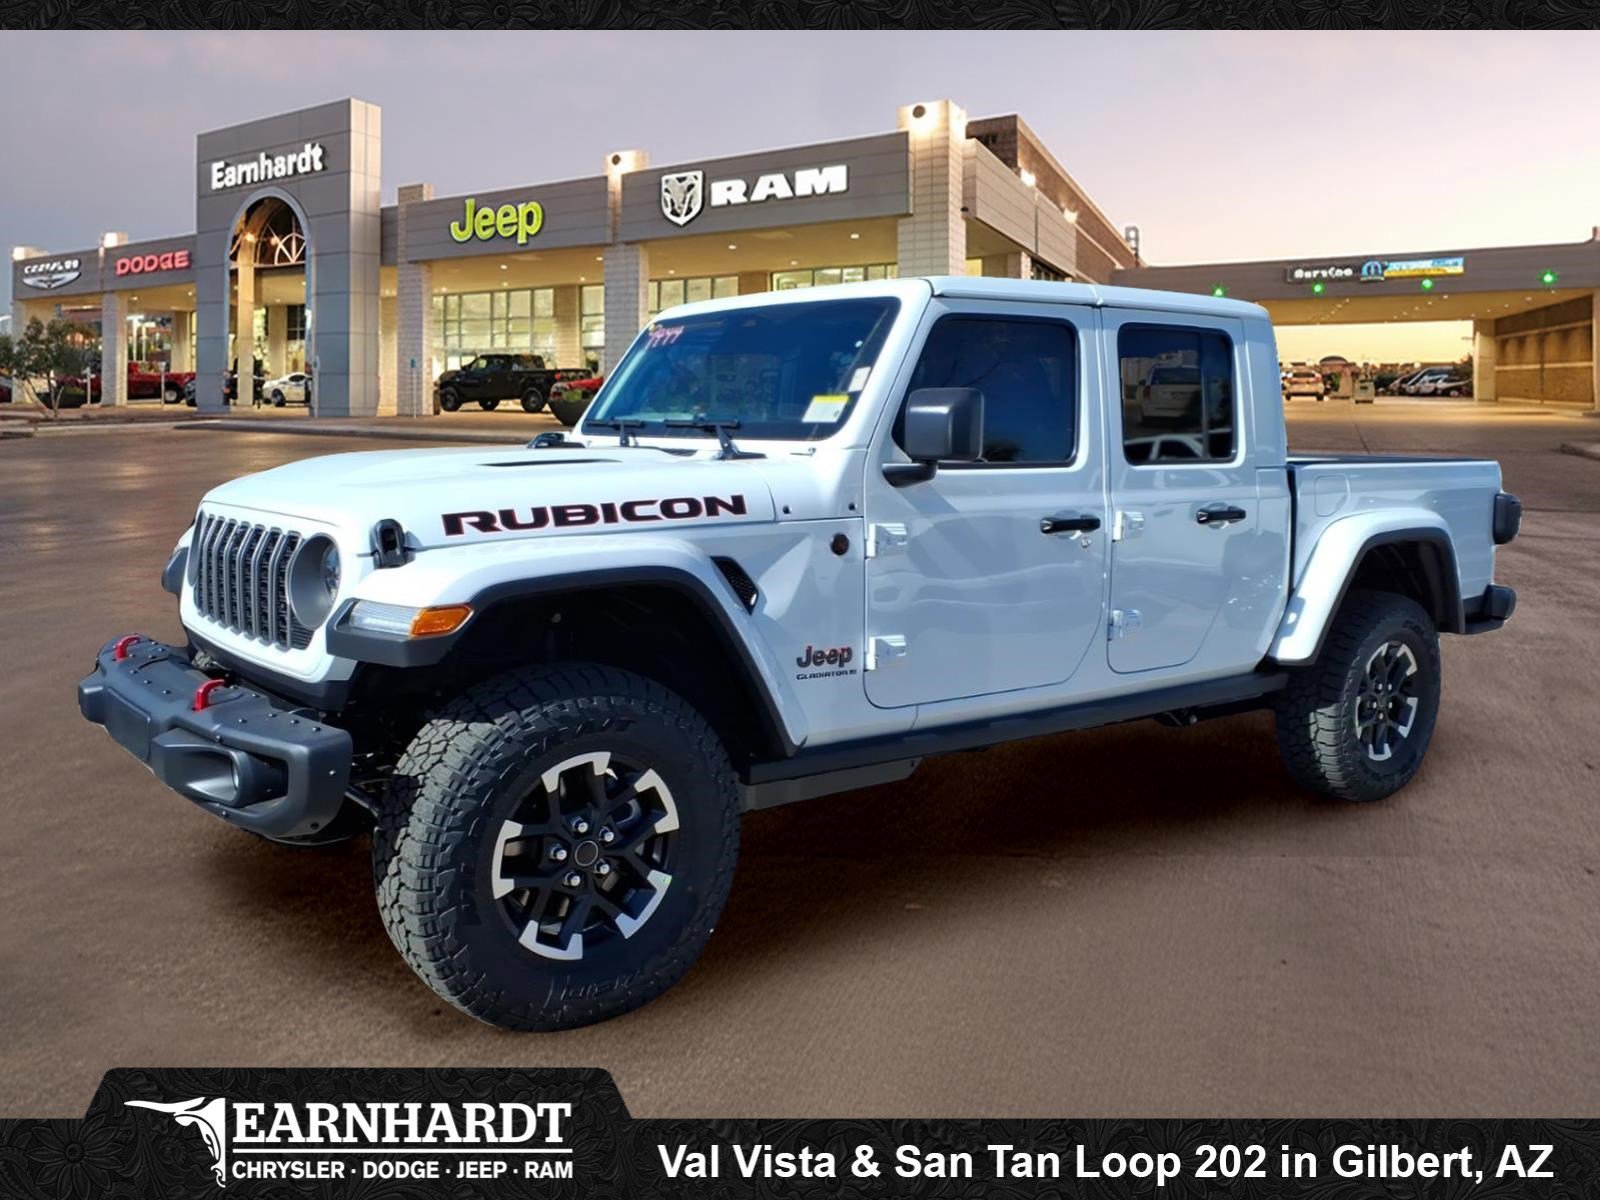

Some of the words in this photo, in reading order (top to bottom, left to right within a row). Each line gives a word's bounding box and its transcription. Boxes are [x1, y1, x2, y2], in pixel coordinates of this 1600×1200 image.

[211, 143, 324, 190] Earnhardt
[710, 164, 848, 207] RAM
[450, 198, 544, 245] Jeep
[116, 249, 191, 277] DODGE
[441, 494, 748, 537] RUBICON
[796, 645, 853, 669] Jeep
[796, 670, 849, 681] GLADIATOR
